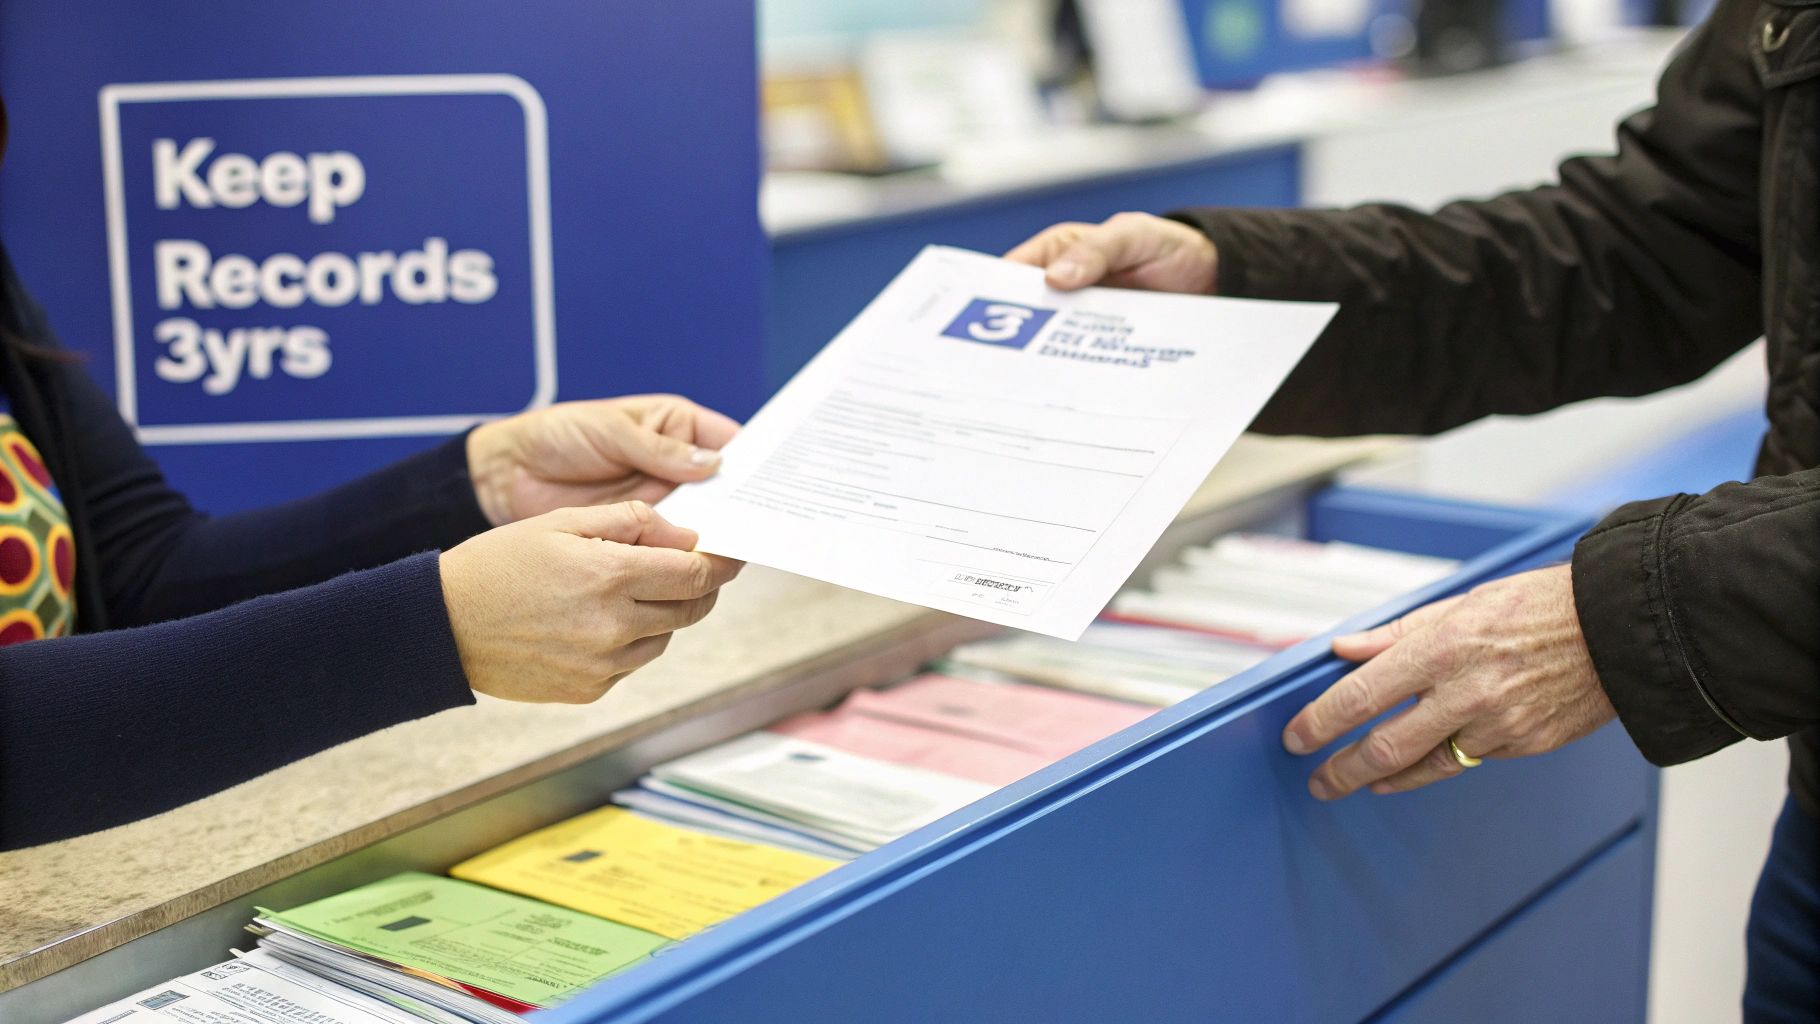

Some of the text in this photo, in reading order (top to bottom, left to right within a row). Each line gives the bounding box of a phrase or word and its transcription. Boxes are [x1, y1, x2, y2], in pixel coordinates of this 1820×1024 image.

[153, 138, 366, 224] Keep
[154, 237, 498, 309] Records
[155, 318, 332, 395] 3yrs
[967, 304, 1034, 342] 3
